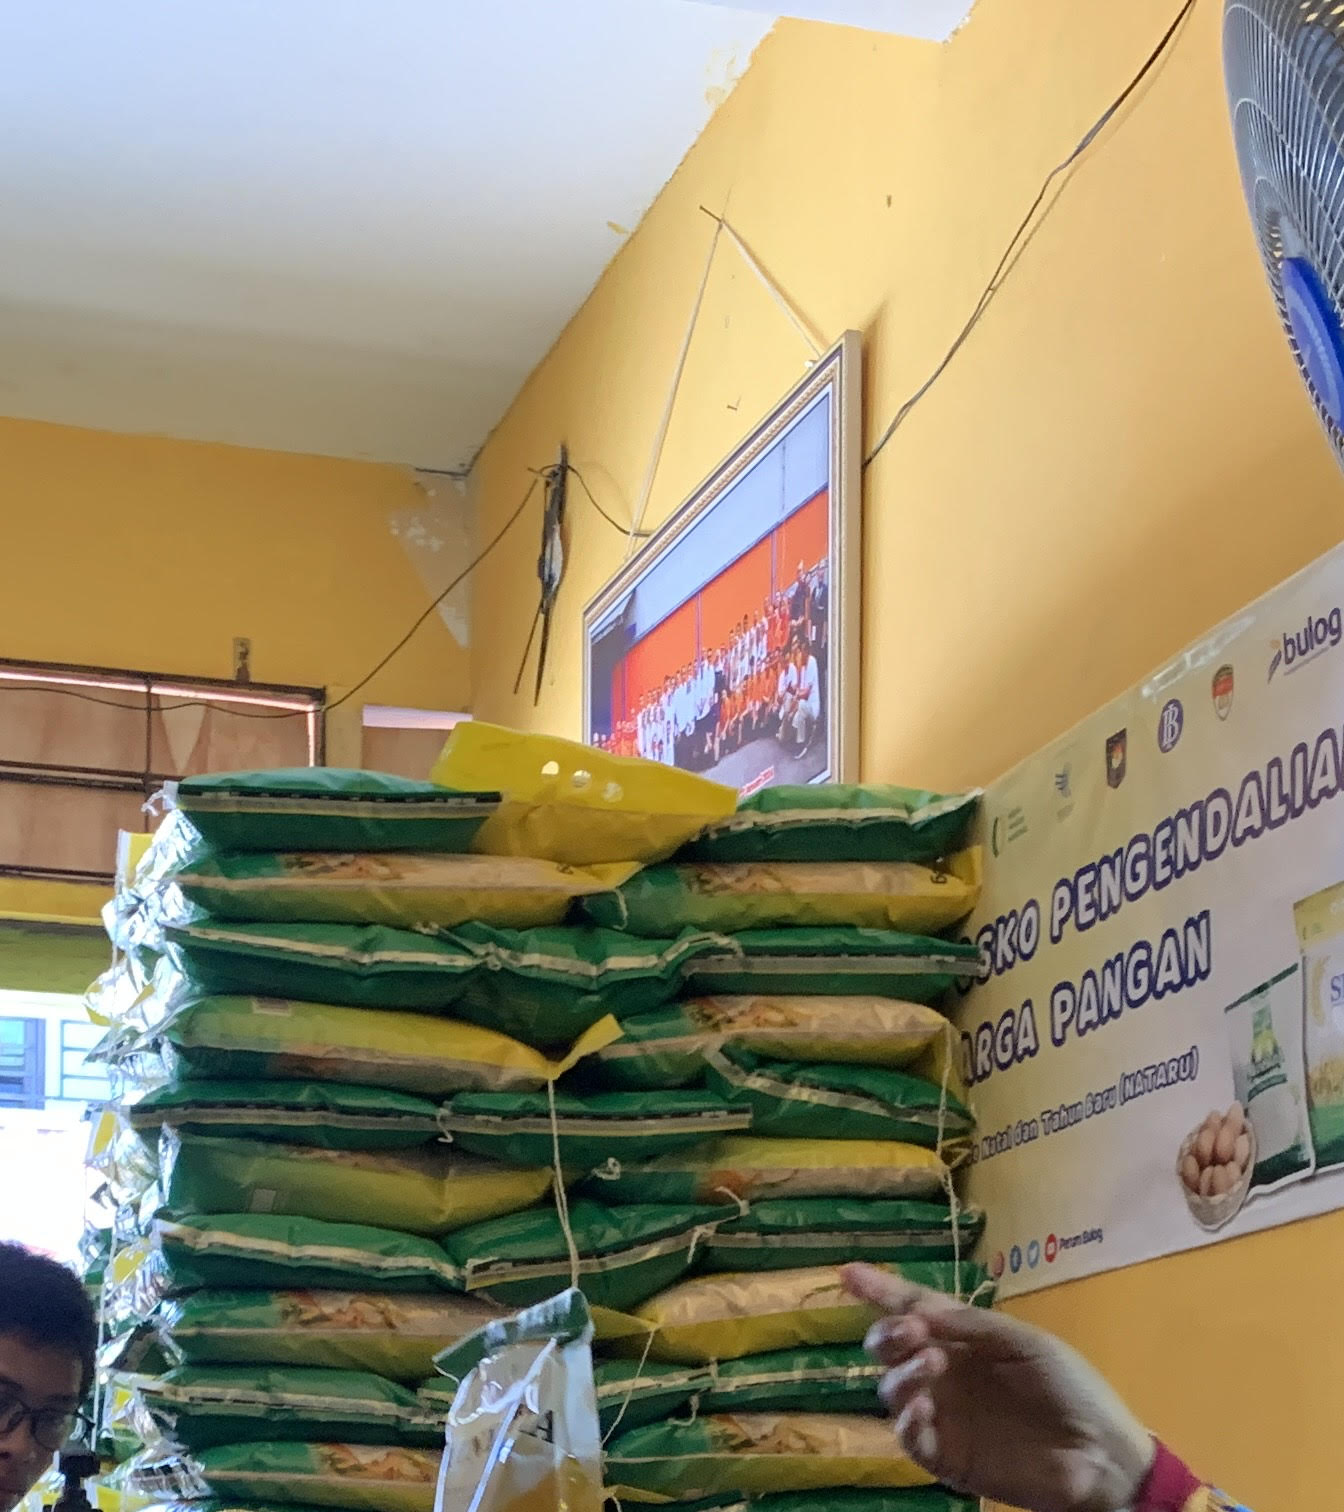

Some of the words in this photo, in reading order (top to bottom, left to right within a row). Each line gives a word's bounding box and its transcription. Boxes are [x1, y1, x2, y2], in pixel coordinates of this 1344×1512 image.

[1283, 608, 1342, 665] bulog
[1050, 909, 1212, 1047] PANGAN
[1014, 1118, 1039, 1147] dan
[1041, 1101, 1084, 1136] Tahun
[1085, 1085, 1117, 1119] Baru
[1118, 1045, 1199, 1106] (NATARU)
